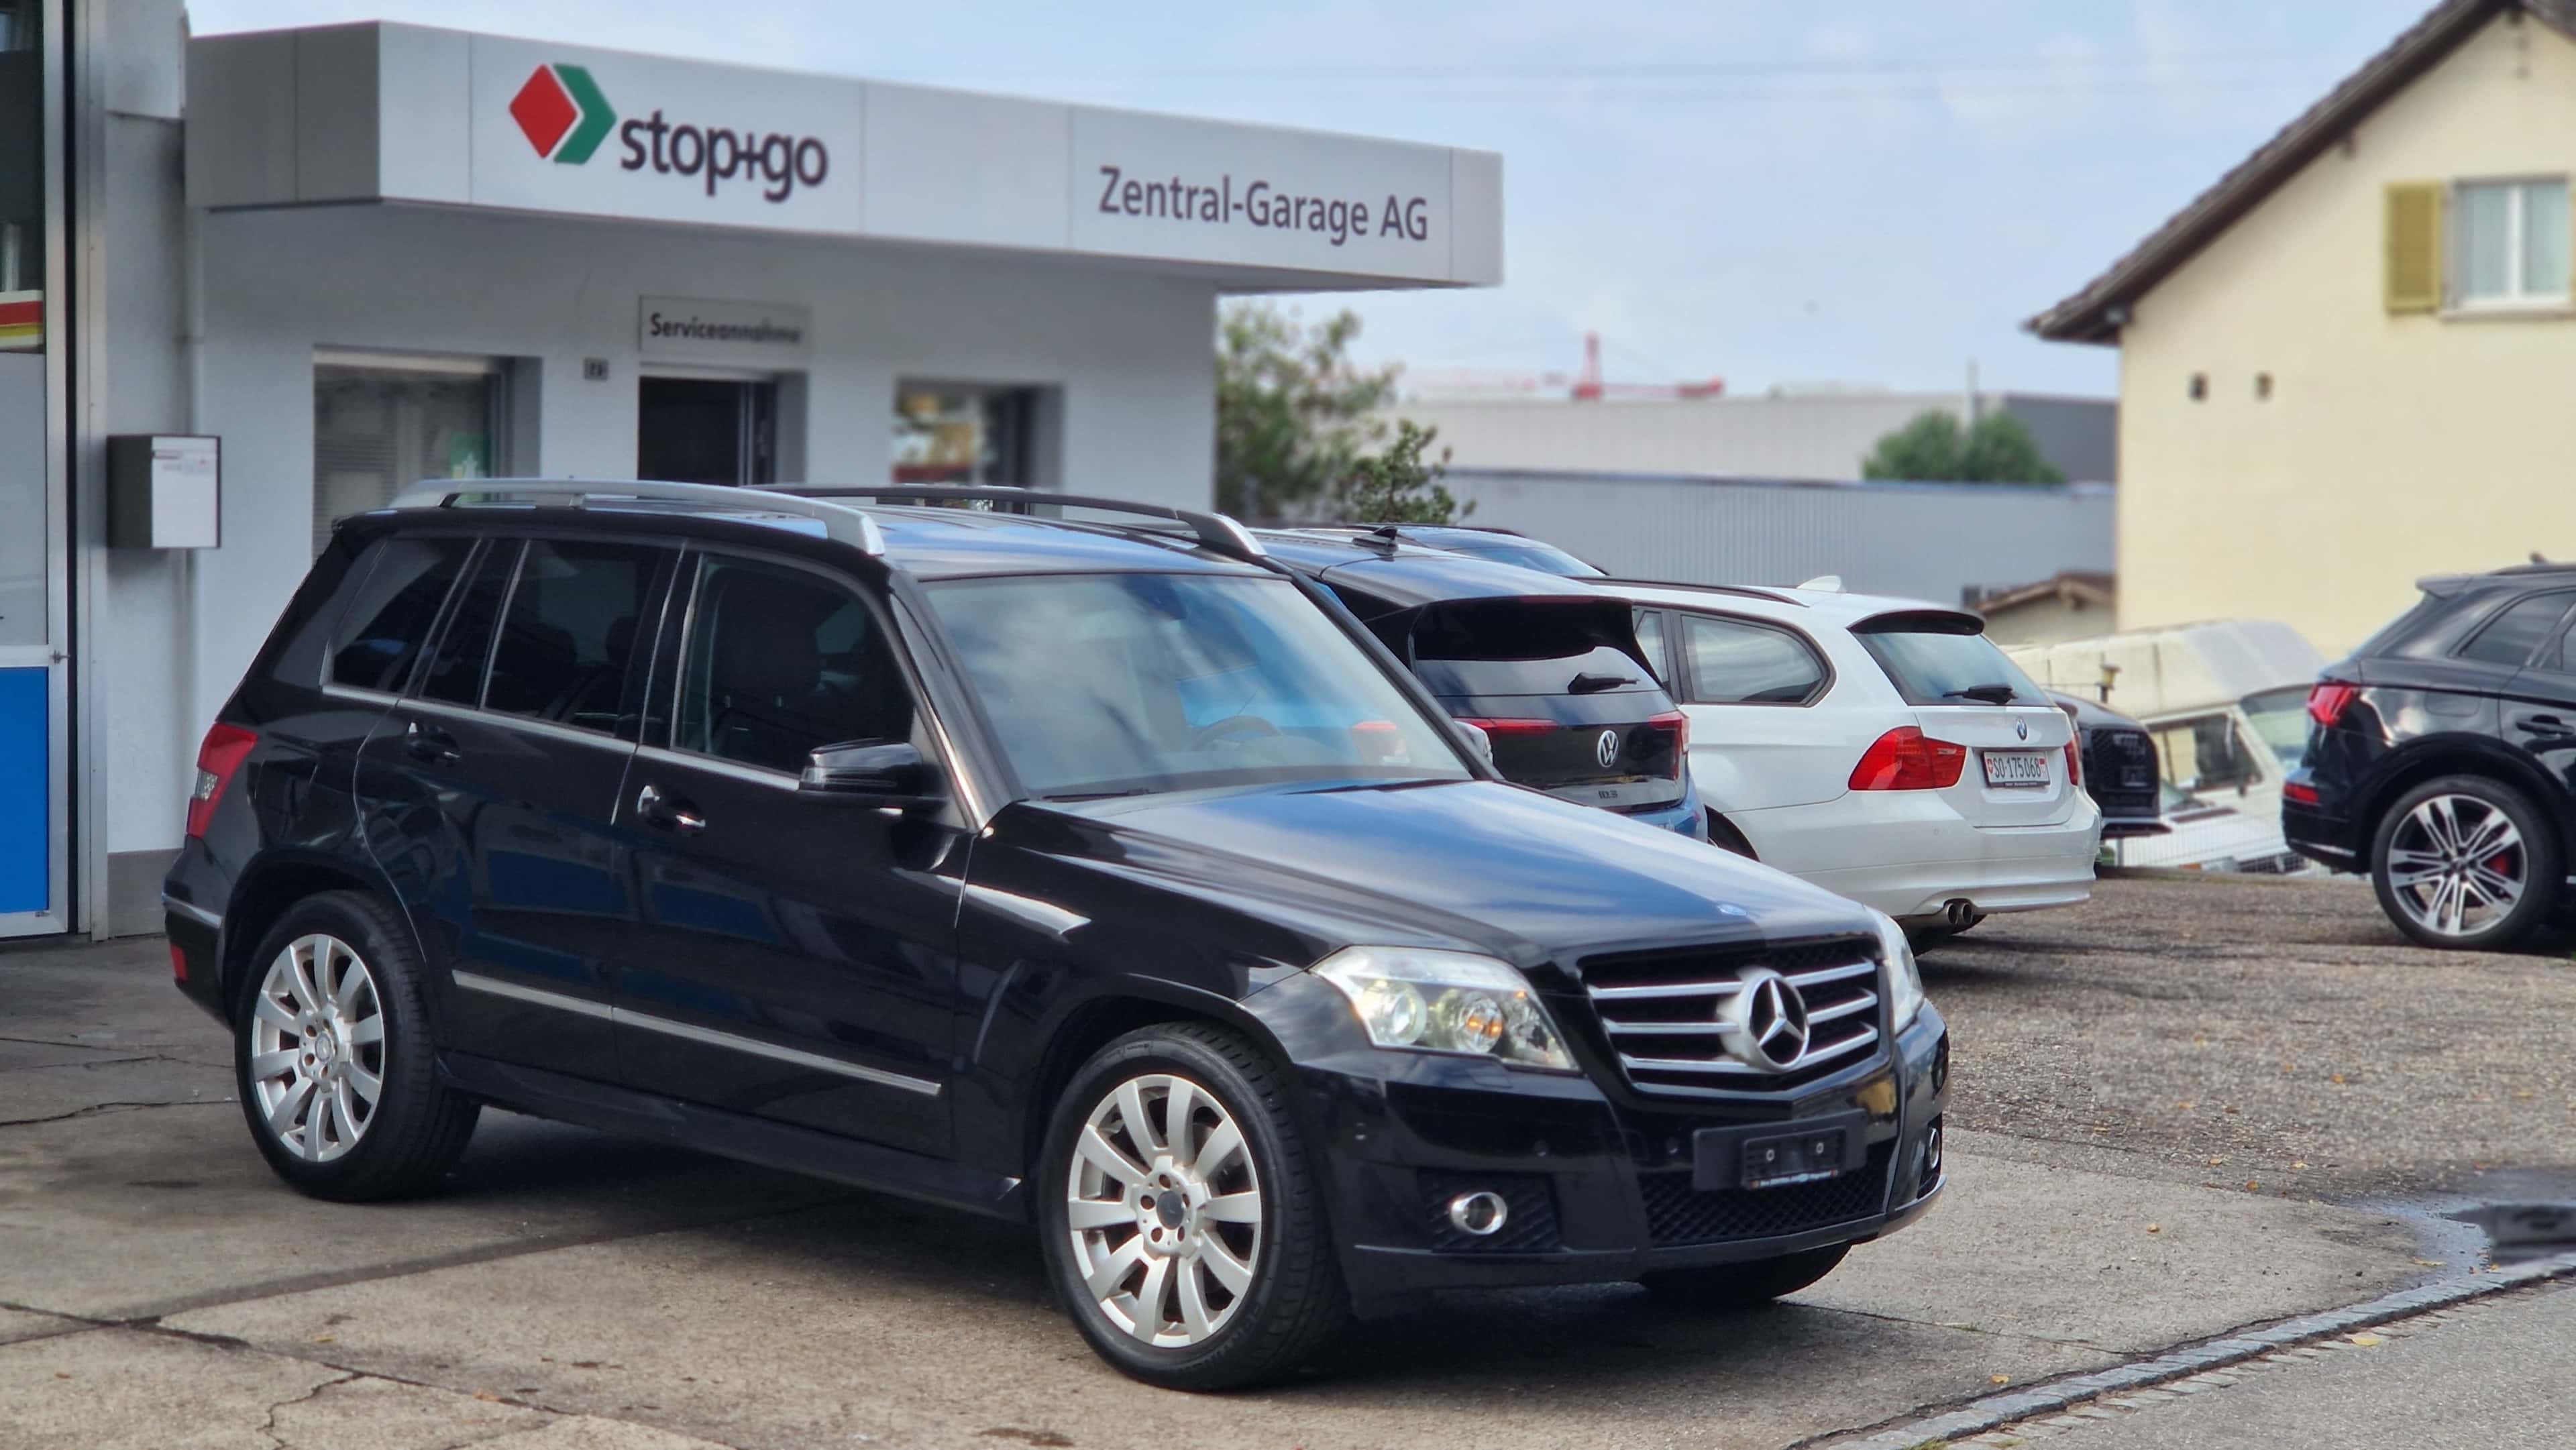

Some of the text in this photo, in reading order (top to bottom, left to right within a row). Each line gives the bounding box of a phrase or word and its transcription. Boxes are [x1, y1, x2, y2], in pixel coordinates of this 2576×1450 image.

[621, 110, 828, 203] stop+go
[1099, 166, 1428, 246] Zentral-Garage AG
